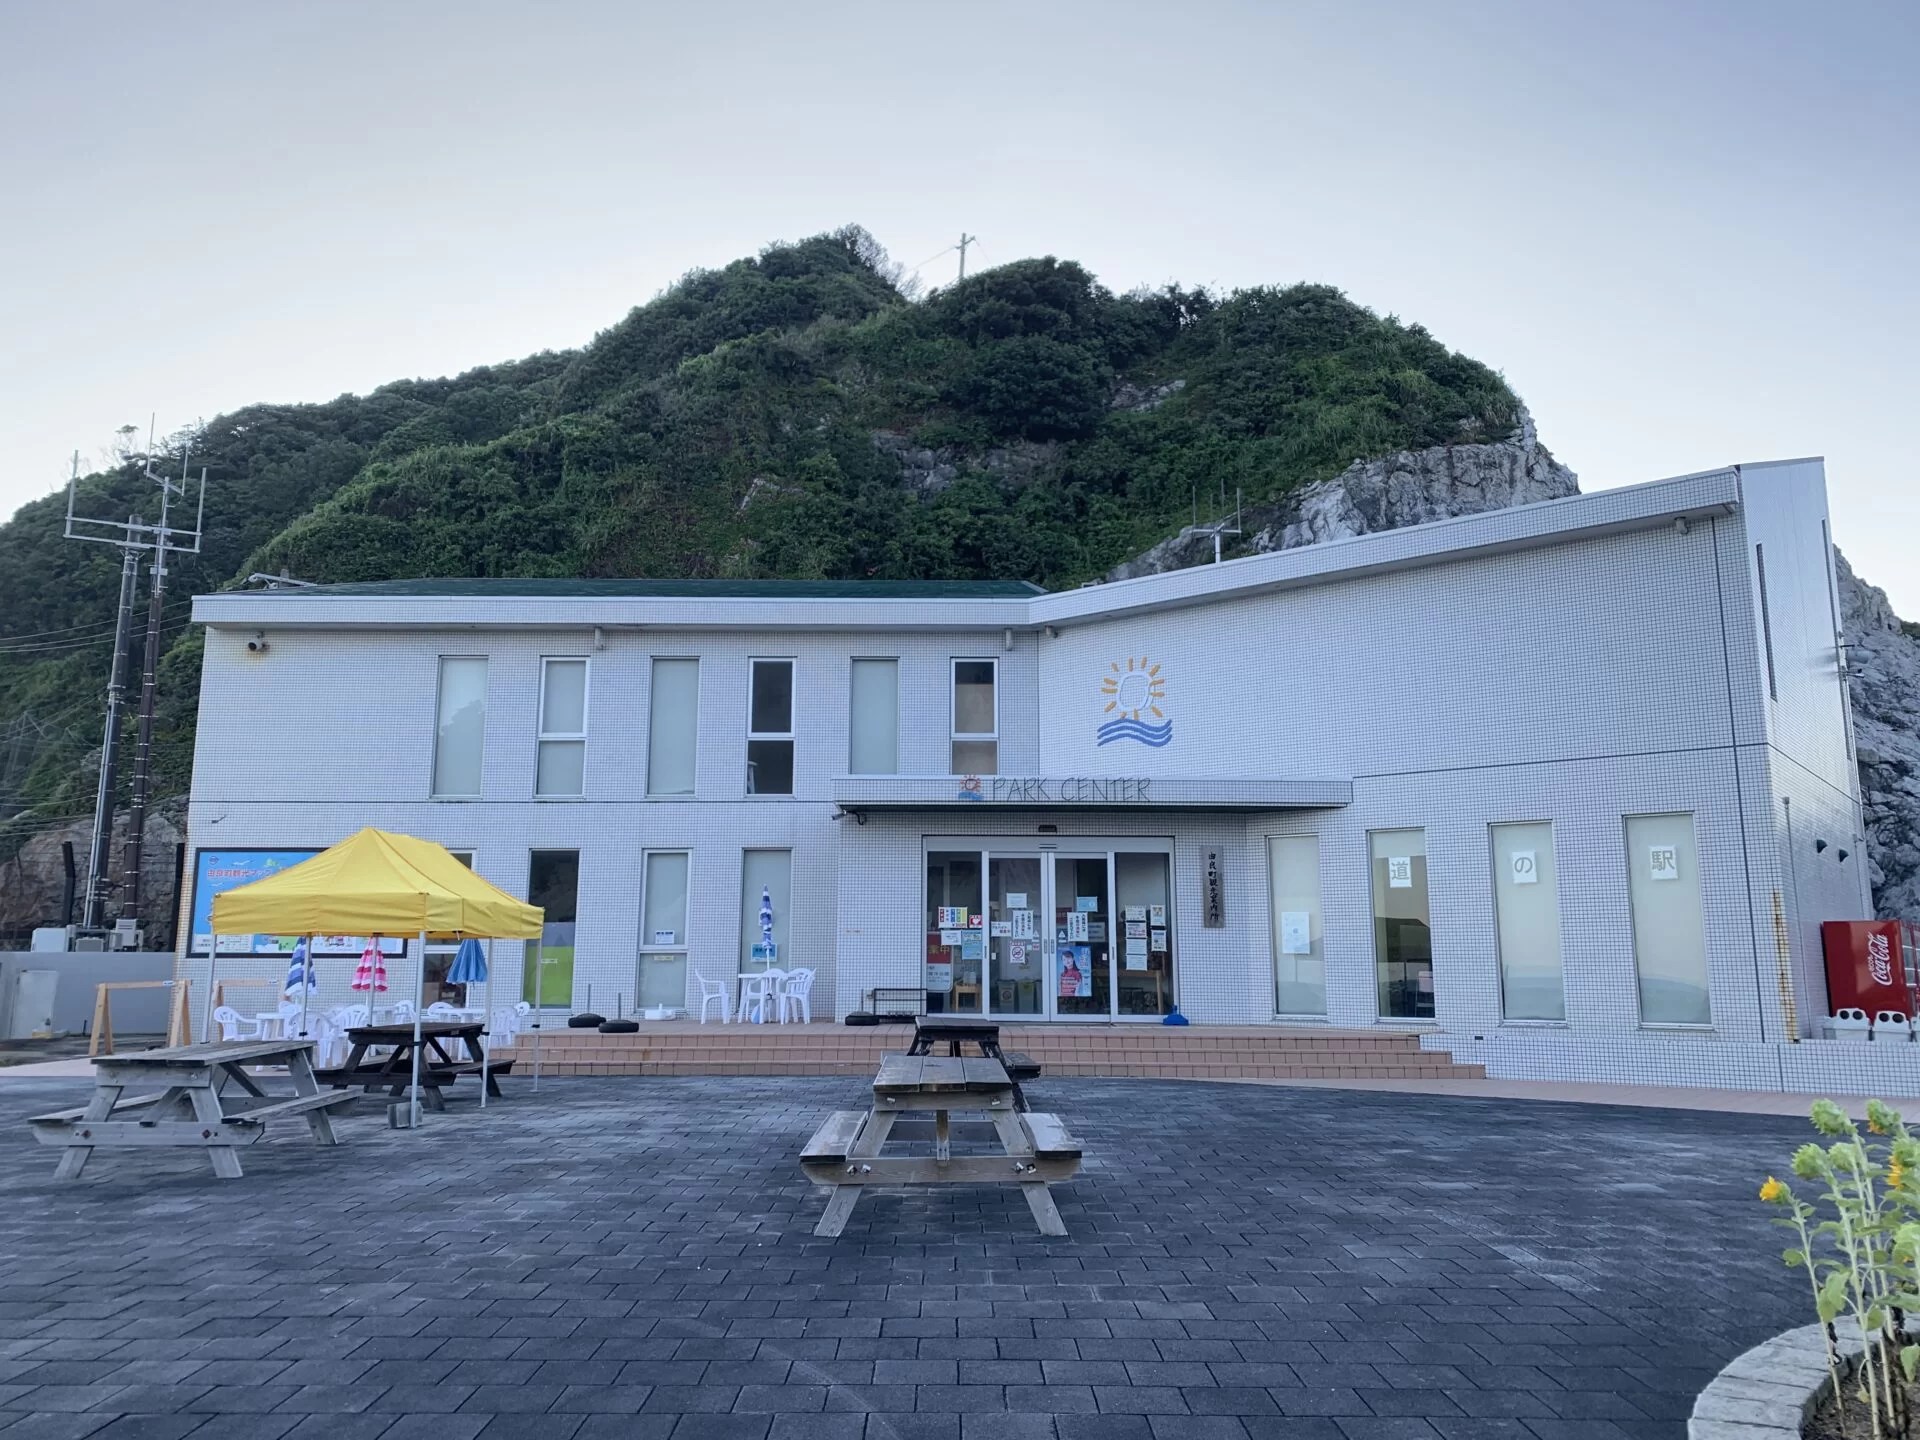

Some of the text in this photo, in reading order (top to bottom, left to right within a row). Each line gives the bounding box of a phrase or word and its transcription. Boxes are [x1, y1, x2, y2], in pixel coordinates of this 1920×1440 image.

[993, 776, 1151, 802] PARK CENTER
[1391, 850, 1675, 880] 道 の 駅
